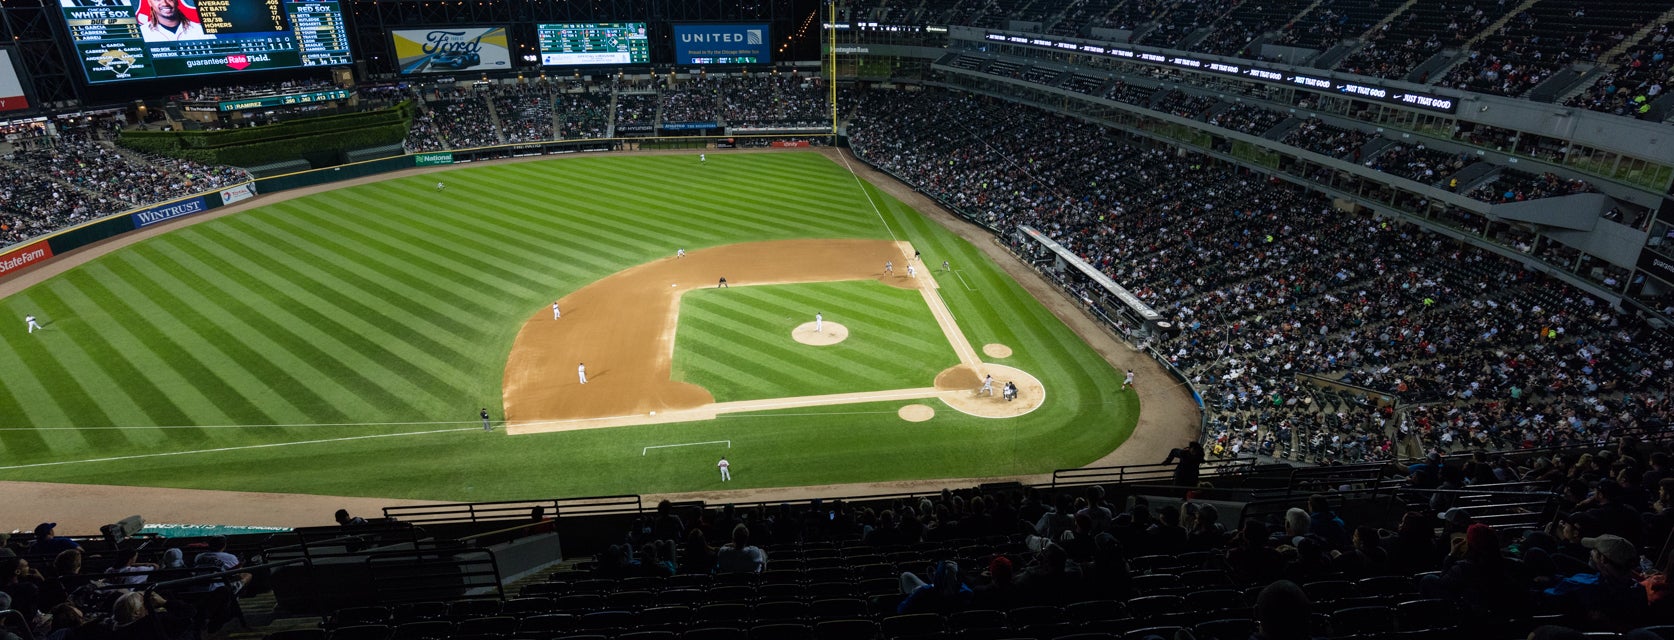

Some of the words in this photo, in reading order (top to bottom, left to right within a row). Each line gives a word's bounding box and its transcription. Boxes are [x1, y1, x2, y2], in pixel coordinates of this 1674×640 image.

[422, 30, 482, 54] Ford
[682, 33, 743, 42] UNITED
[187, 58, 228, 68] guaranteed
[1305, 78, 1316, 86] THAT
[1316, 79, 1330, 88] GOOD
[1346, 84, 1357, 93] JUST
[1358, 86, 1370, 95] THAT
[1370, 88, 1386, 98] GOOD
[1403, 94, 1417, 103] JUST
[1418, 96, 1432, 106] THAT
[1433, 98, 1451, 109] GOOD
[138, 201, 200, 223] WINTRUST
